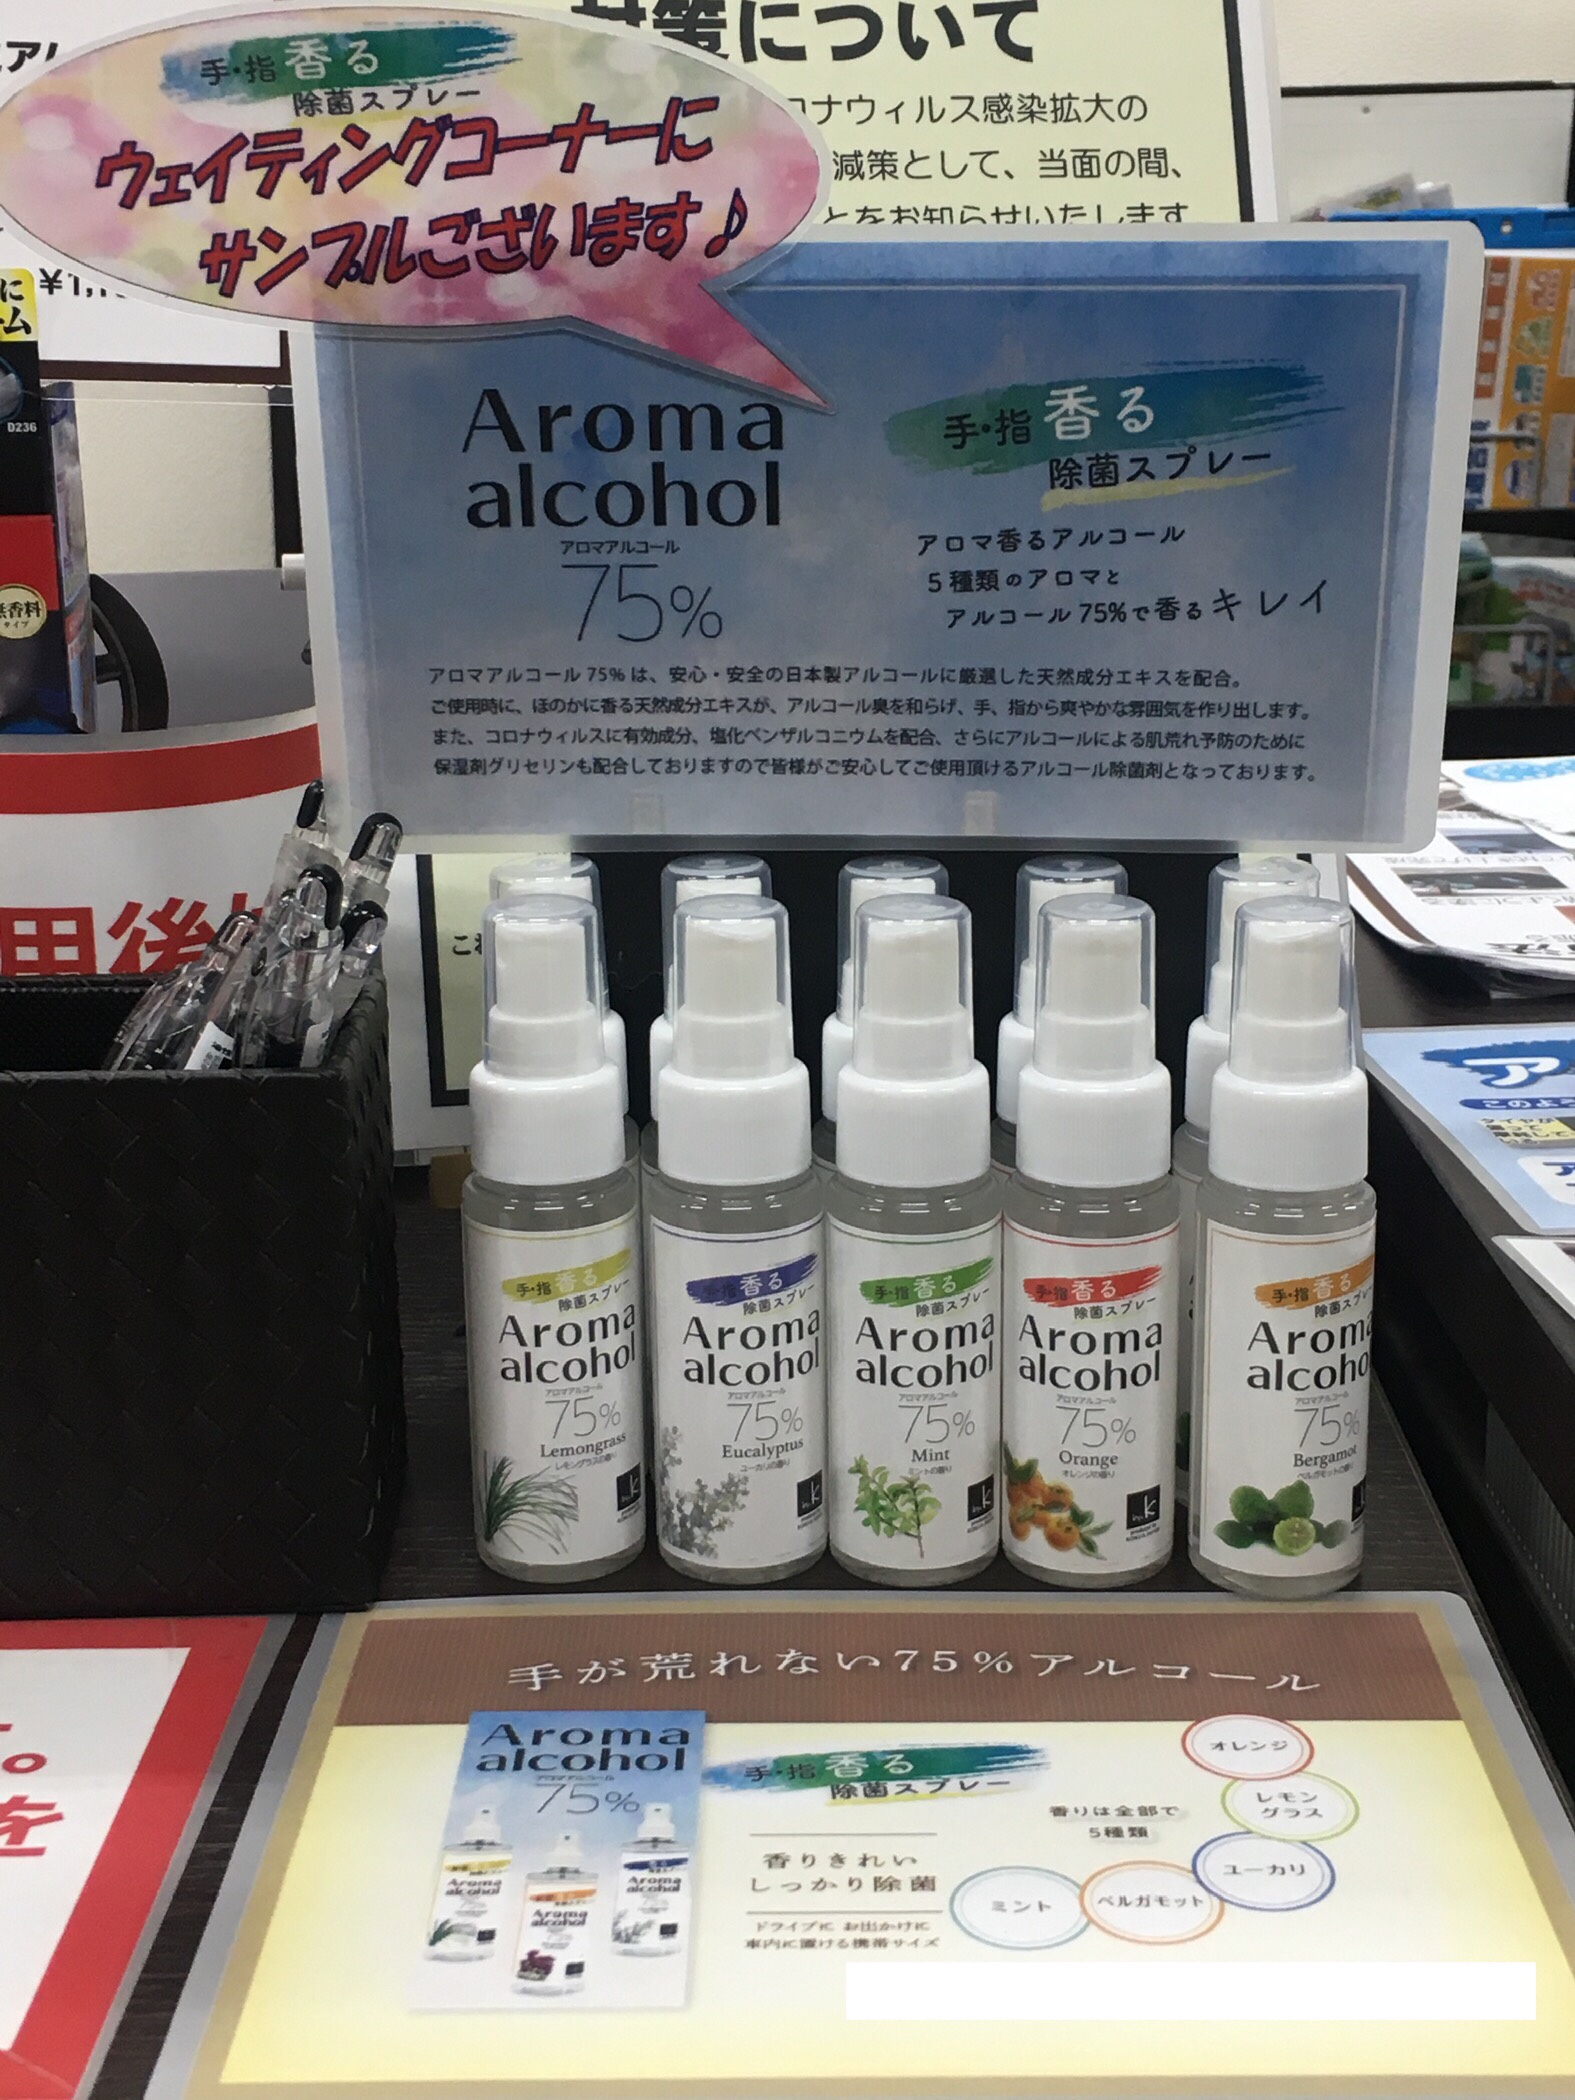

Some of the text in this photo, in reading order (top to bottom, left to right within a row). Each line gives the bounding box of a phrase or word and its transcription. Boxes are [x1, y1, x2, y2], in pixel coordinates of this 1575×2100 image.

[293, 84, 481, 118] 除菌スプレー
[95, 96, 719, 210] ウェイティングコーナーに
[462, 388, 783, 453] Aroma
[1049, 445, 1271, 490] 除菌スプレー
[467, 461, 780, 528] alcohol
[560, 539, 680, 555] アロマアルコール
[917, 525, 1186, 556] アロマ香るアルコール
[562, 564, 723, 643] 75%
[559, 1279, 629, 1312] 除菌スプレー
[743, 1284, 815, 1315] 除菌スプレー
[916, 1288, 989, 1317] 除菌スプレー
[1074, 1297, 1156, 1320] 除菌スプレー
[499, 1304, 635, 1347] Aroma
[683, 1309, 819, 1350] Aroma
[855, 1313, 994, 1352] Aroma
[1019, 1314, 1162, 1355] Aroma
[501, 1330, 635, 1384] alcohol
[684, 1336, 819, 1387] alcohol
[856, 1340, 993, 1388] alcohol
[1019, 1350, 1160, 1391] alcohol
[1247, 1351, 1371, 1391] alcoho
[545, 1395, 621, 1439] 75%
[727, 1400, 803, 1442] 75%
[898, 1403, 975, 1444] 75%
[1056, 1405, 1136, 1447] 75%
[1294, 1404, 1359, 1448] 75%
[540, 1432, 626, 1458] Lemongrass
[722, 1438, 804, 1460] Eucalyptus
[911, 1449, 950, 1462] Mint
[1059, 1450, 1118, 1468] Orange
[481, 1723, 690, 1746] Aroma
[1211, 1738, 1289, 1753] オレンジ
[476, 1748, 685, 1772] alcohol
[536, 1782, 640, 1815] 75%
[830, 1777, 1011, 1800] 除菌スプレー
[1256, 1791, 1318, 1804] レモン
[1049, 1804, 1179, 1818] 香りは全部で
[1260, 1806, 1323, 1819] グラス
[1089, 1826, 1149, 1840] 5種類
[763, 1852, 917, 1869] 香りきれい
[1223, 1863, 1306, 1877] ユーカリ
[751, 1875, 937, 1893] しっかり除菌
[991, 1899, 1052, 1912] ミント
[1098, 1894, 1204, 1908] ベルガモット
